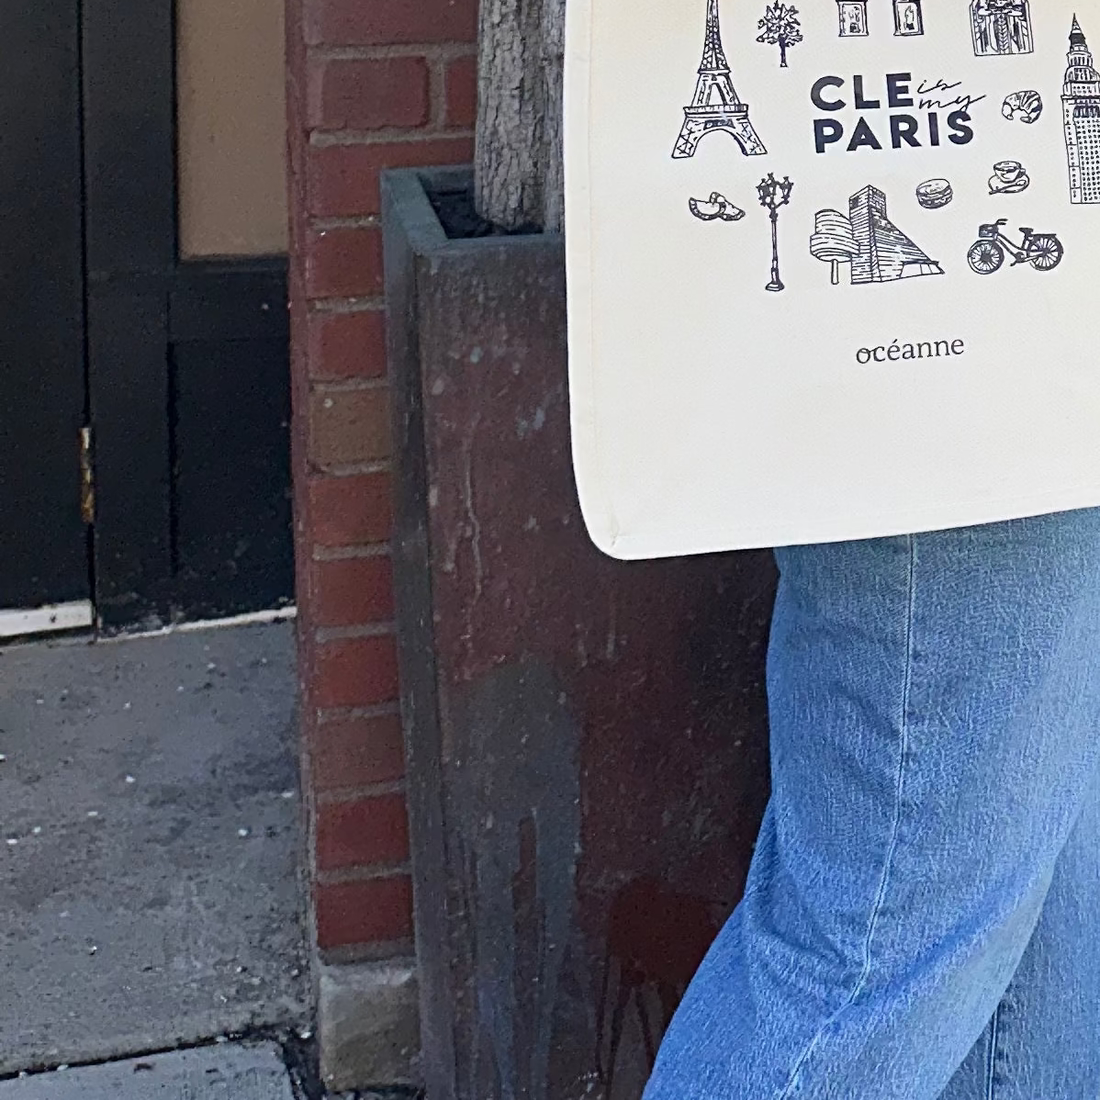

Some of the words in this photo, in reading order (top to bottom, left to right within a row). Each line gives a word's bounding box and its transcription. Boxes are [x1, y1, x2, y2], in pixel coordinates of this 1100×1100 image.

[810, 72, 914, 111] CLE
[917, 78, 962, 94] is
[918, 94, 987, 112] my
[813, 110, 974, 154] PARIS
[855, 338, 965, 364] océanne
